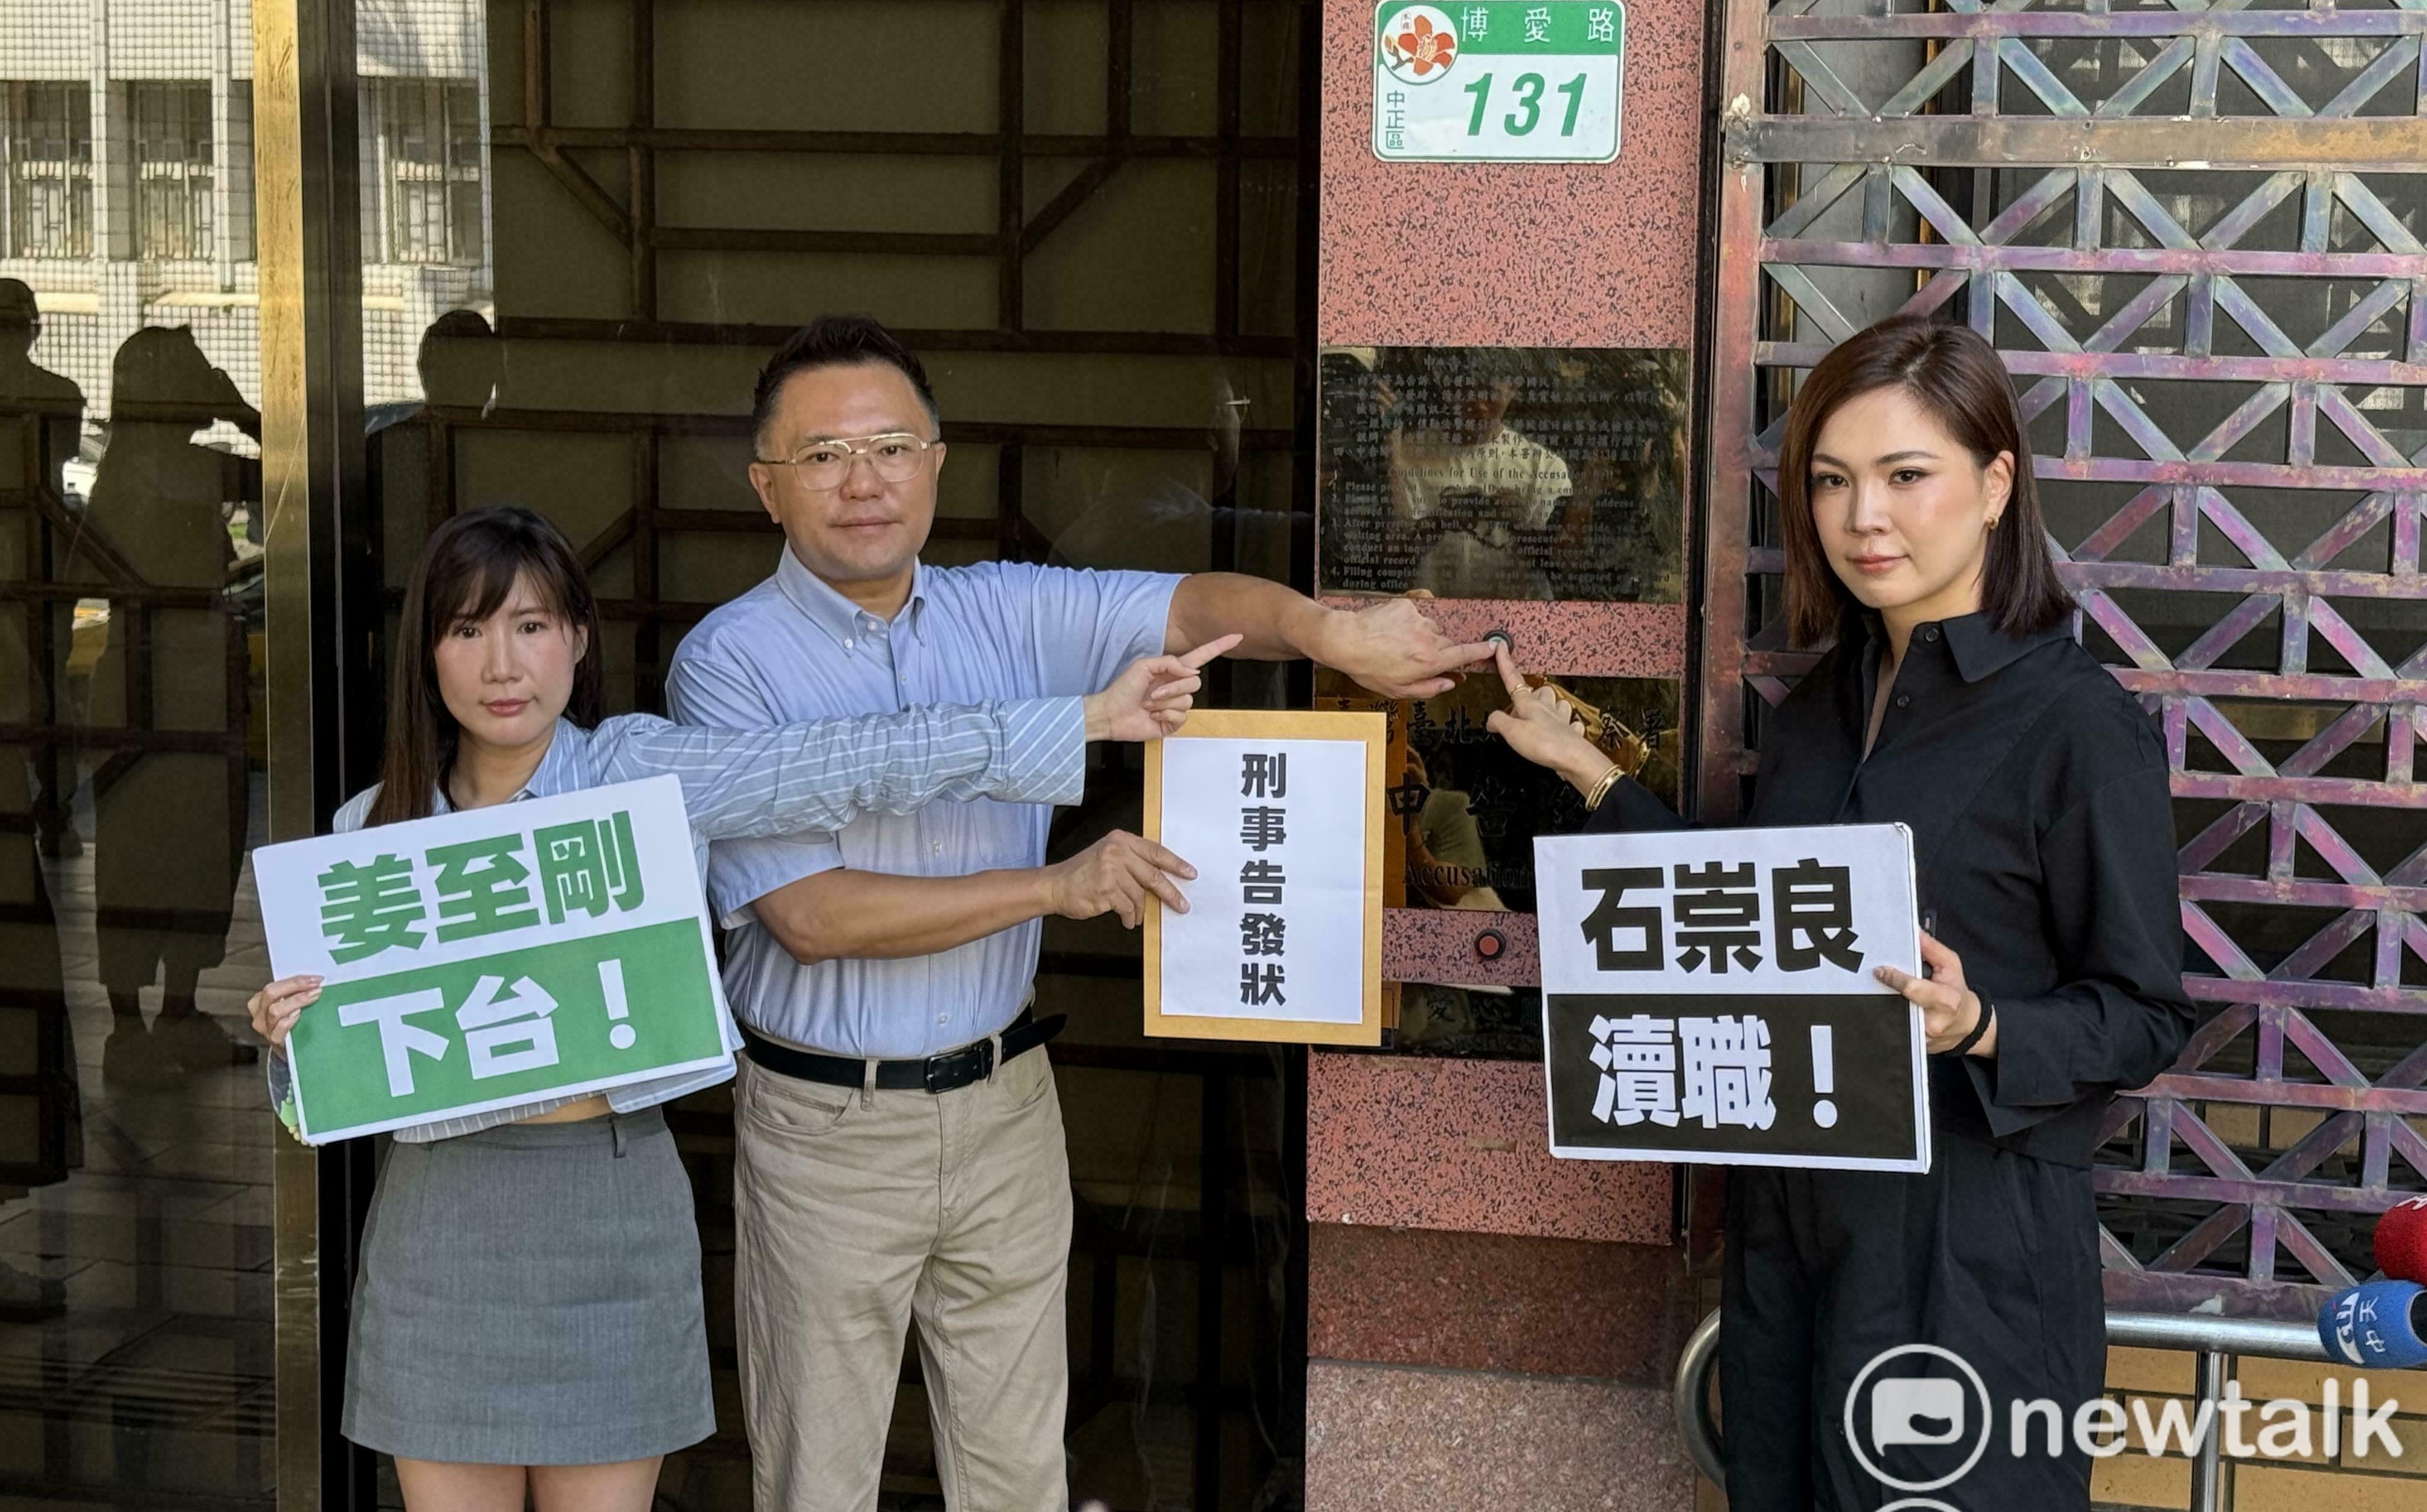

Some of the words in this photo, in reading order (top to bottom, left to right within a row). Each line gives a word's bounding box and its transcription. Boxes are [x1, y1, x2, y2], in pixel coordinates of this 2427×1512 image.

[1460, 7, 1615, 43] 博愛路
[1464, 73, 1587, 137] 131
[1386, 90, 1405, 150] 中正區
[1449, 468, 1464, 477] for
[1493, 468, 1504, 479] of
[1508, 468, 1525, 480] the
[1345, 482, 1376, 492] Please
[1451, 496, 1490, 506] provide
[1595, 498, 1634, 508] address
[1344, 518, 1371, 528] After
[1421, 519, 1436, 529] the
[1344, 531, 1381, 542] waiting
[1344, 544, 1383, 553] conduct
[1517, 546, 1553, 556] official
[1344, 554, 1378, 565] official
[1383, 555, 1416, 565] record
[1342, 578, 1376, 590] during
[1381, 580, 1408, 589] office
[1344, 566, 1372, 578] Filing
[317, 810, 645, 965] 姜至剛
[1239, 752, 1287, 1006] 刑事告發狀
[1581, 858, 1865, 974] 石崇良
[338, 958, 637, 1097] 下台！
[1589, 1014, 1838, 1130] 瀆職！
[2359, 1296, 2386, 1353] 中天
